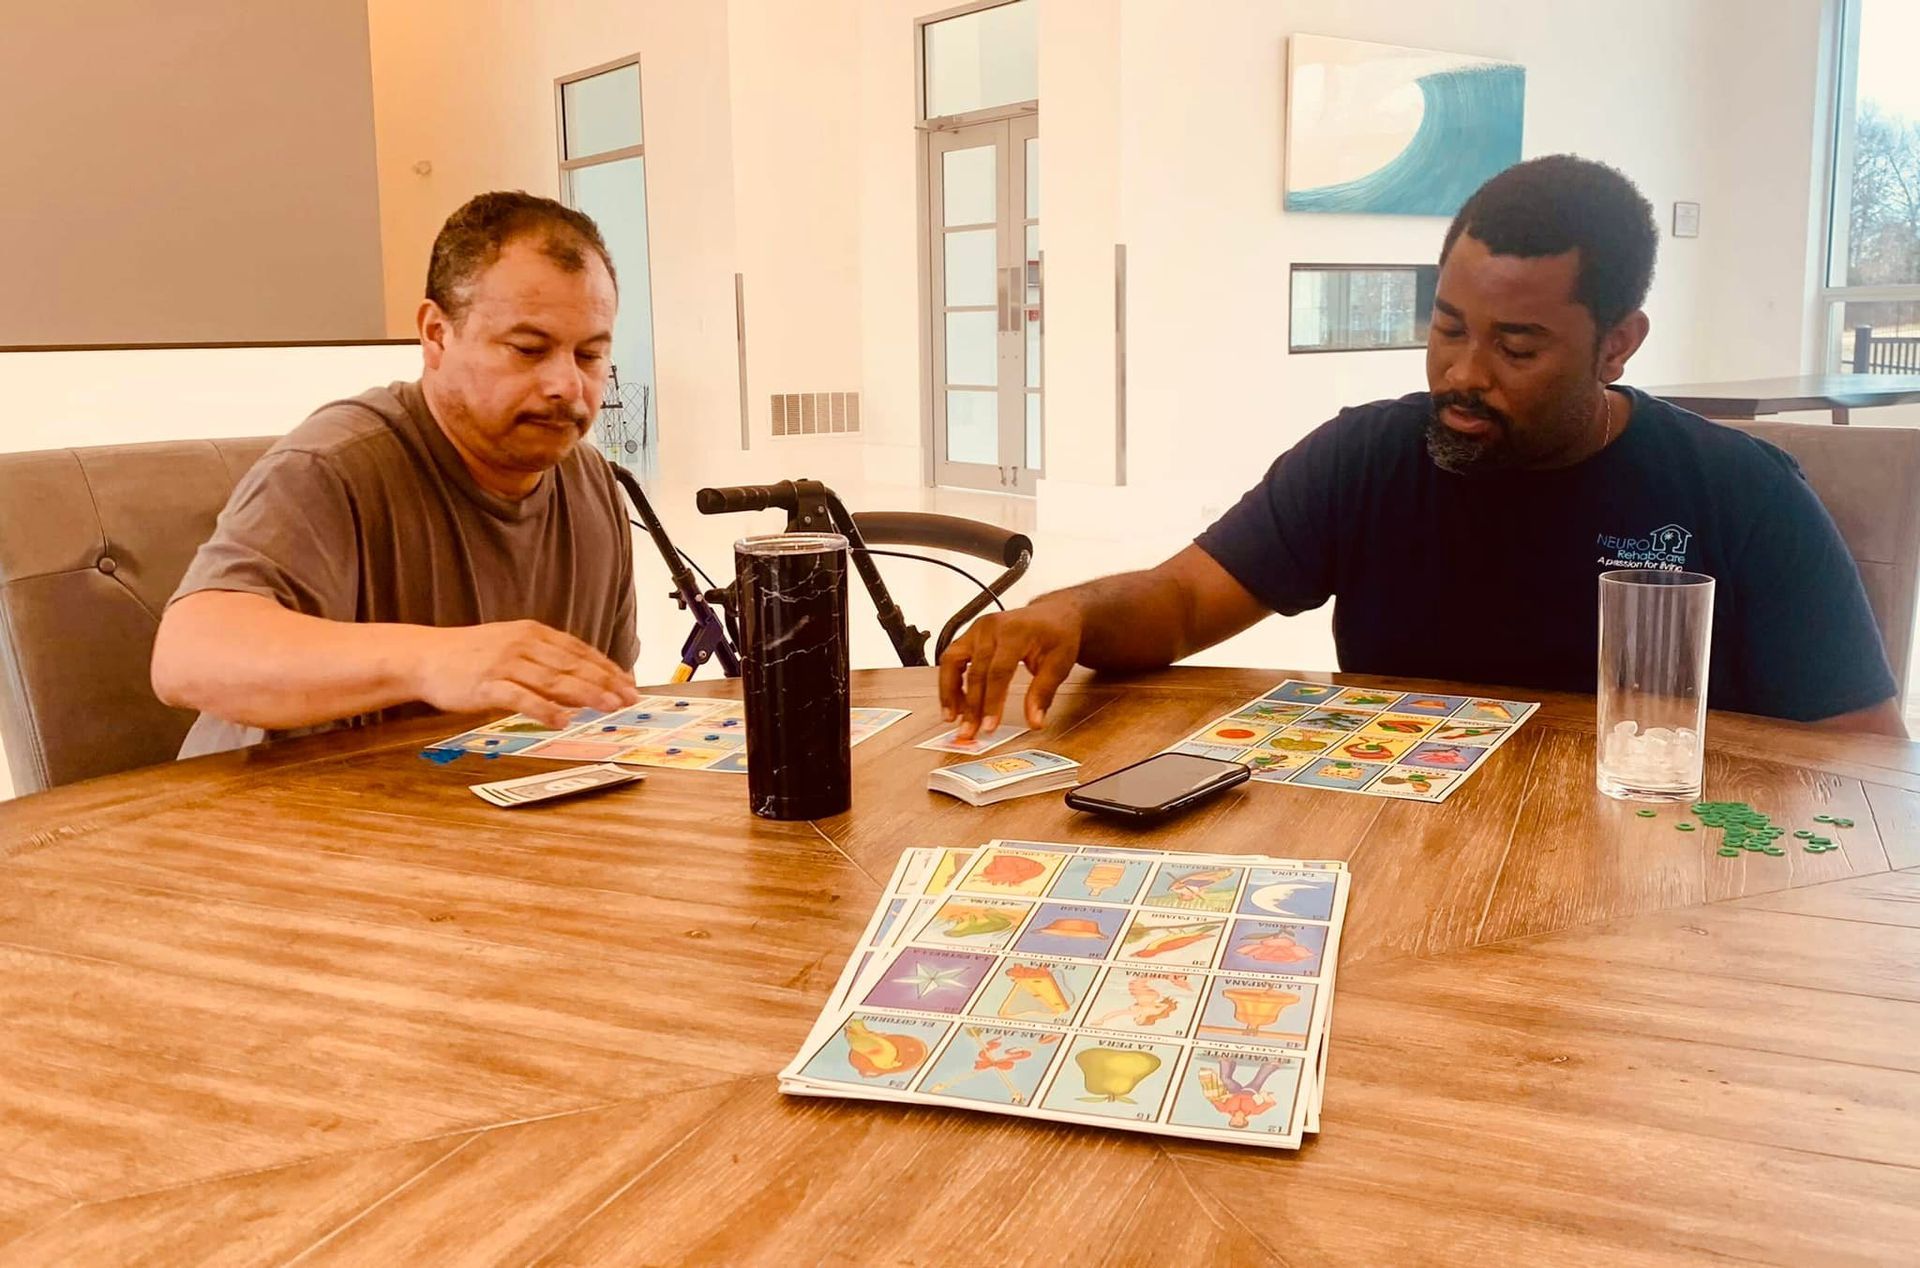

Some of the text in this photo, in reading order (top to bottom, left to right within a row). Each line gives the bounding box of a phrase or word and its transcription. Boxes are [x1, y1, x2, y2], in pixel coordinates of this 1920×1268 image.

[1596, 533, 1650, 550] NEURO
[1596, 556, 1605, 564] A
[1604, 557, 1643, 569] passion
[1644, 559, 1658, 569] for
[1617, 549, 1686, 564] RehabCare
[1271, 870, 1299, 878] LUNA
[1029, 960, 1059, 969] ARPA
[1124, 970, 1170, 980] SIRENA
[1172, 974, 1188, 982] LA
[1224, 978, 1303, 991] LA CAMPANA
[862, 1014, 937, 1028] EL COTORRO
[1021, 1031, 1046, 1040] LAS
[1097, 1039, 1155, 1052] LA PERA
[1201, 1050, 1291, 1065] EL VALIENTE
[1267, 1124, 1285, 1134] 12
